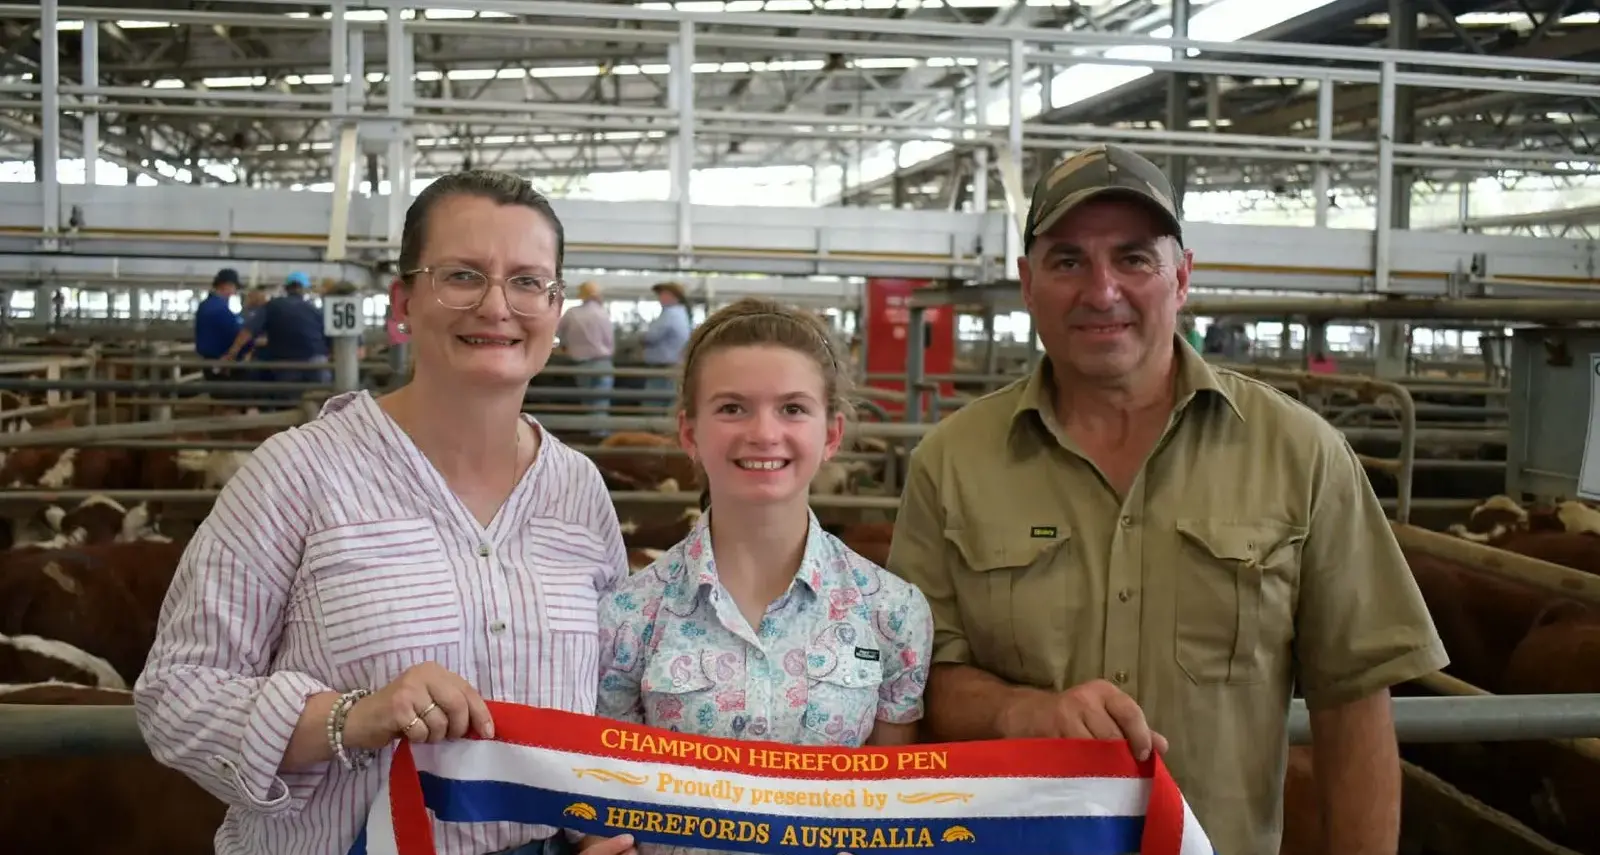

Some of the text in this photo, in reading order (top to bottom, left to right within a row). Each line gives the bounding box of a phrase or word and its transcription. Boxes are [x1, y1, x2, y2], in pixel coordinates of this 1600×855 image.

[332, 302, 356, 329] 56
[601, 728, 948, 772] CHAMPION HEREFORD PEN
[656, 772, 889, 811] Proudly presented by
[604, 806, 934, 848] HEREFORDS AUSTRALIA
